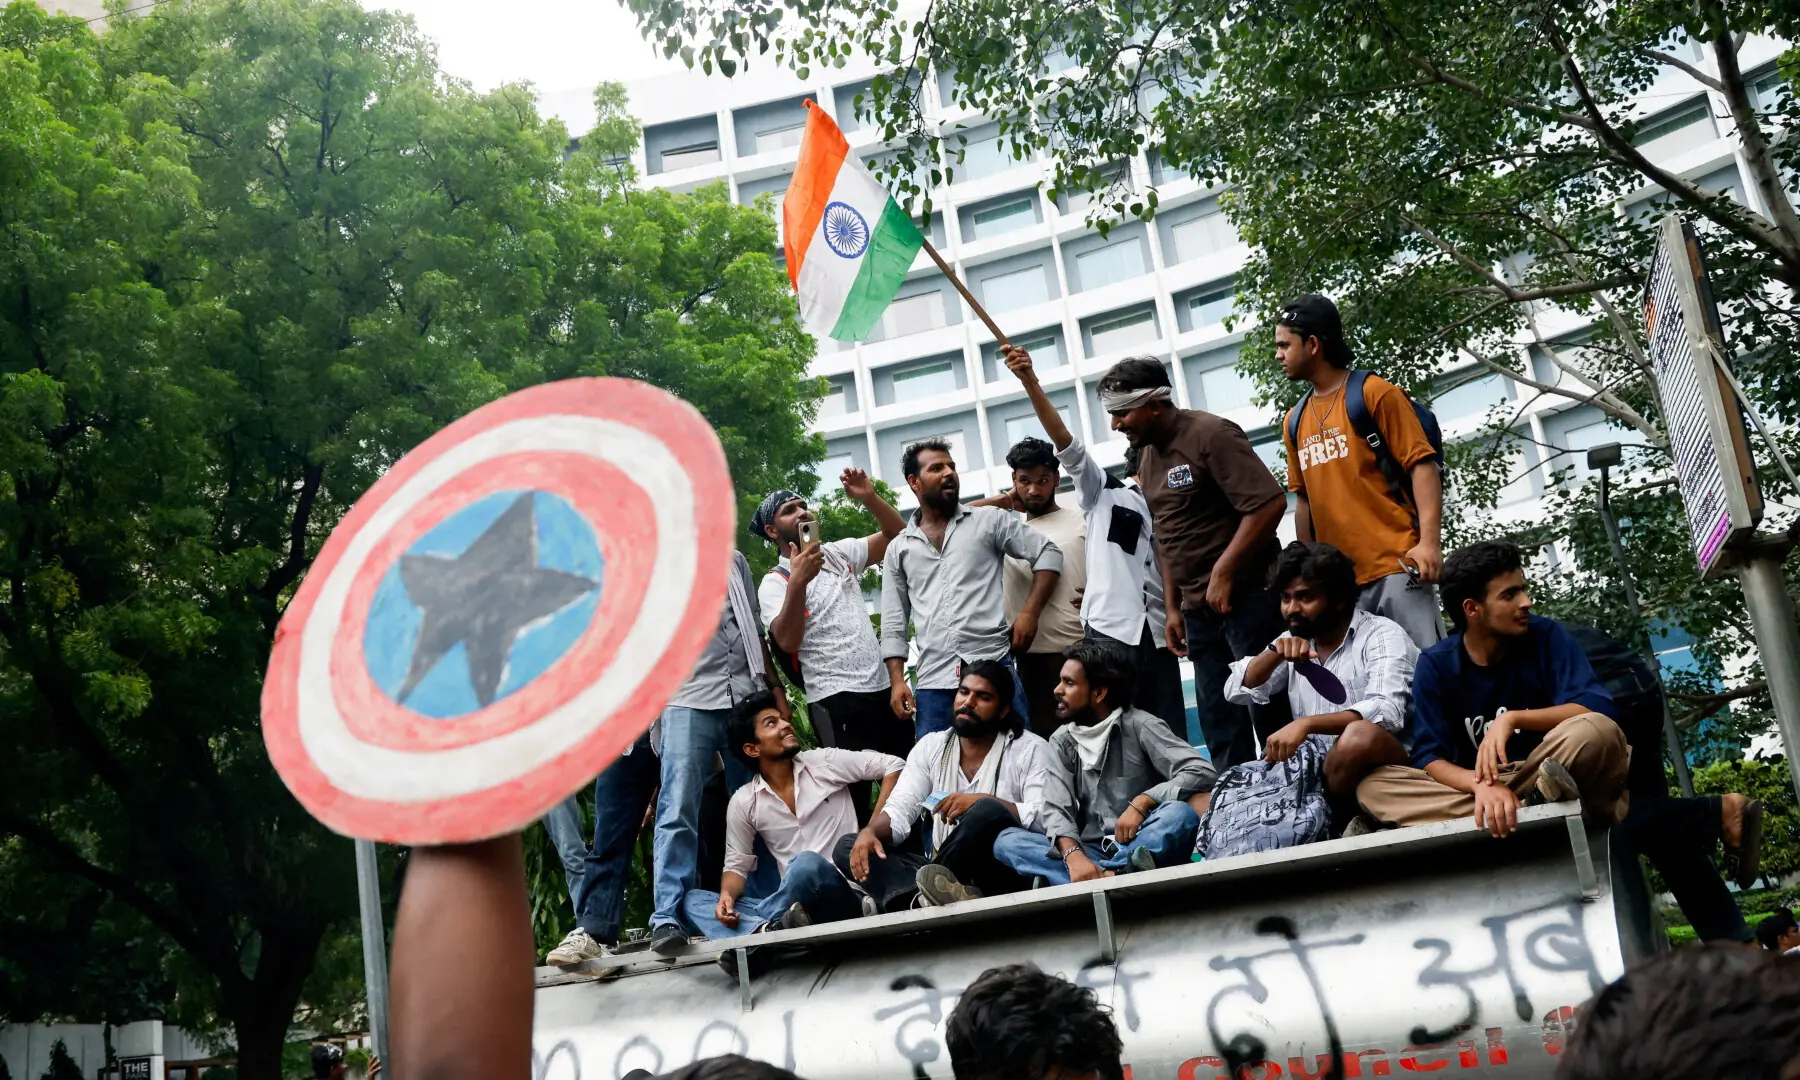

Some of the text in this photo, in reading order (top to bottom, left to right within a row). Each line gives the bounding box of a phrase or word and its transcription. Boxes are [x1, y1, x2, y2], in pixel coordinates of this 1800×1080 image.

[1302, 434, 1321, 448] LAND
[1327, 427, 1341, 438] THE
[1297, 434, 1349, 472] FREE
[1177, 1023, 1509, 1080] Council
[123, 1062, 149, 1073] THE
